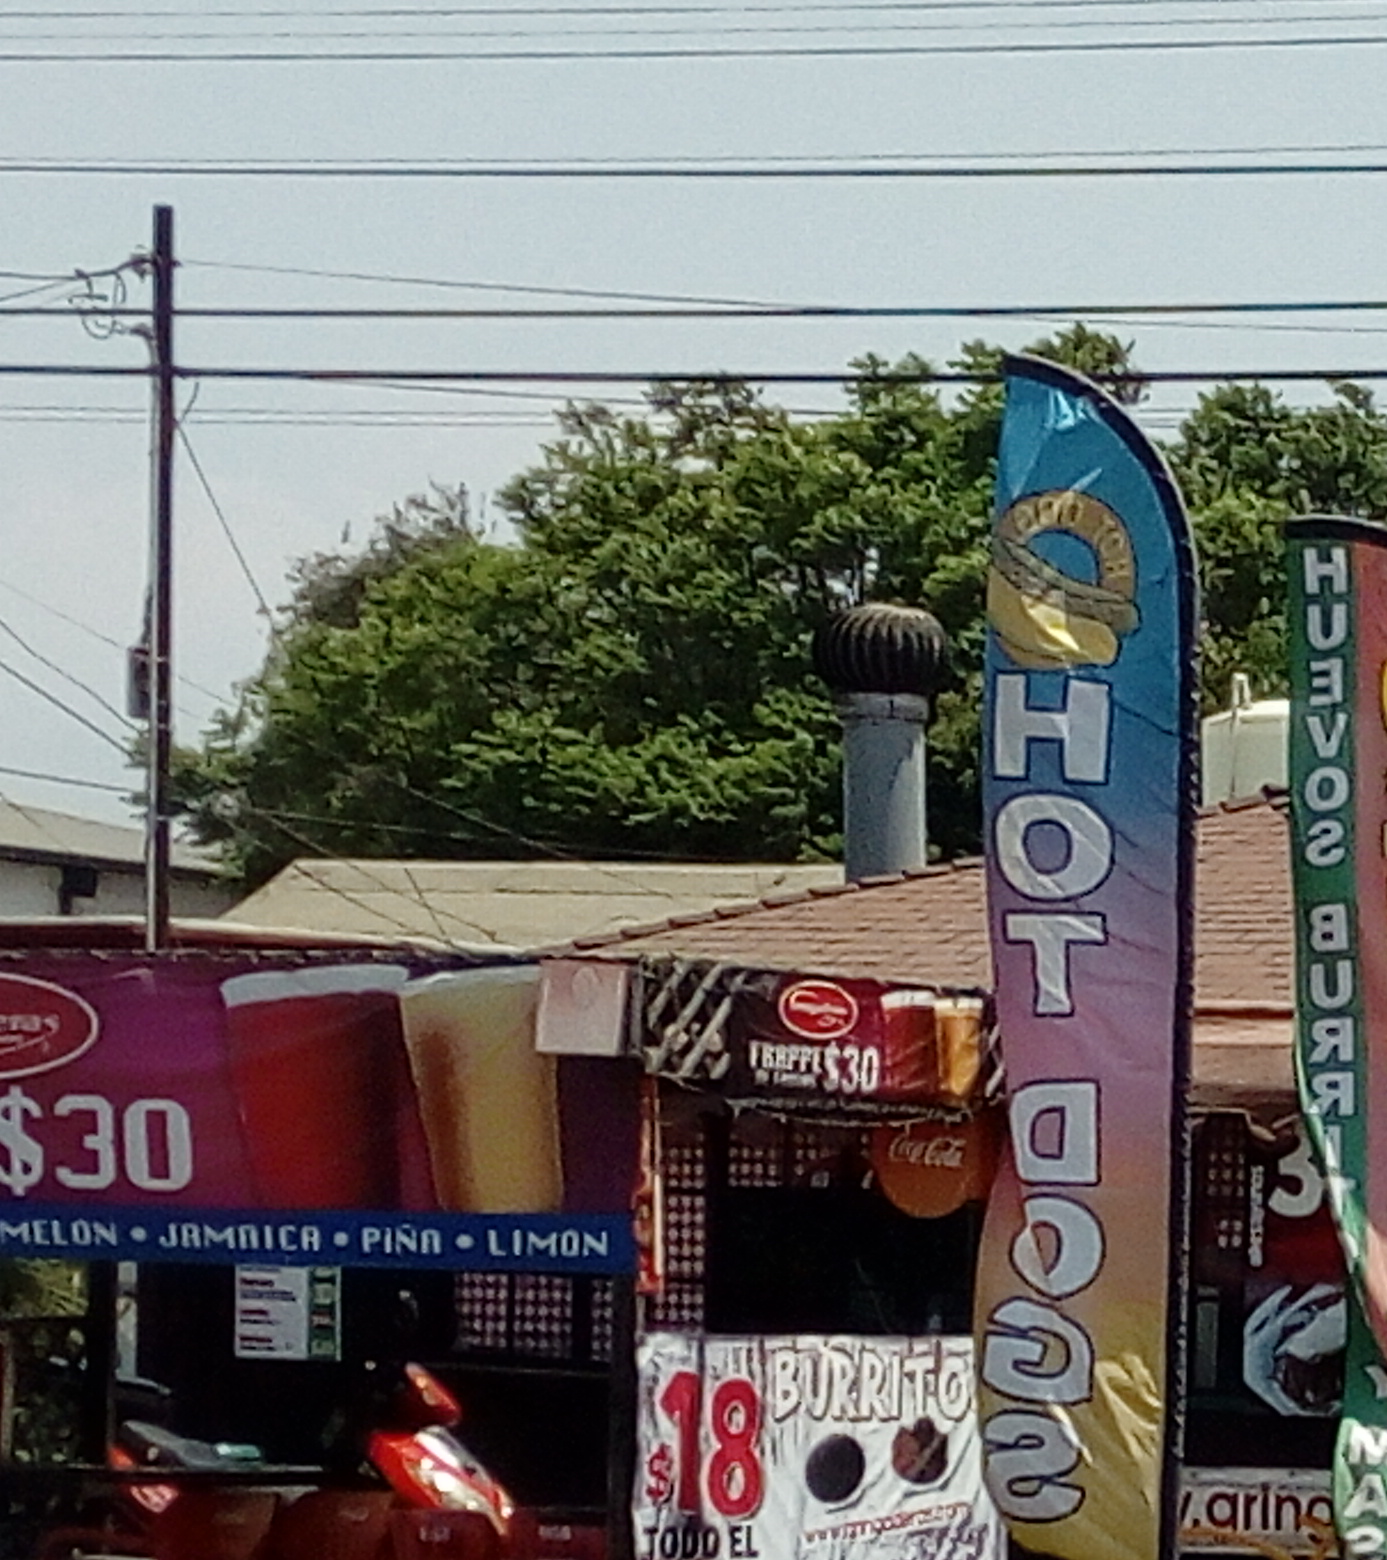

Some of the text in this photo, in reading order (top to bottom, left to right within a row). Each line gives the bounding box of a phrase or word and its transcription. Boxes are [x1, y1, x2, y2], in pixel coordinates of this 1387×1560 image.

[823, 1041, 881, 1093] $30
[0, 1085, 194, 1196] $30
[0, 1217, 609, 1259] MELON JAMAICA PIÑA LIMON
[772, 1349, 974, 1424] BURRITO
[729, 1525, 759, 1559] EL
